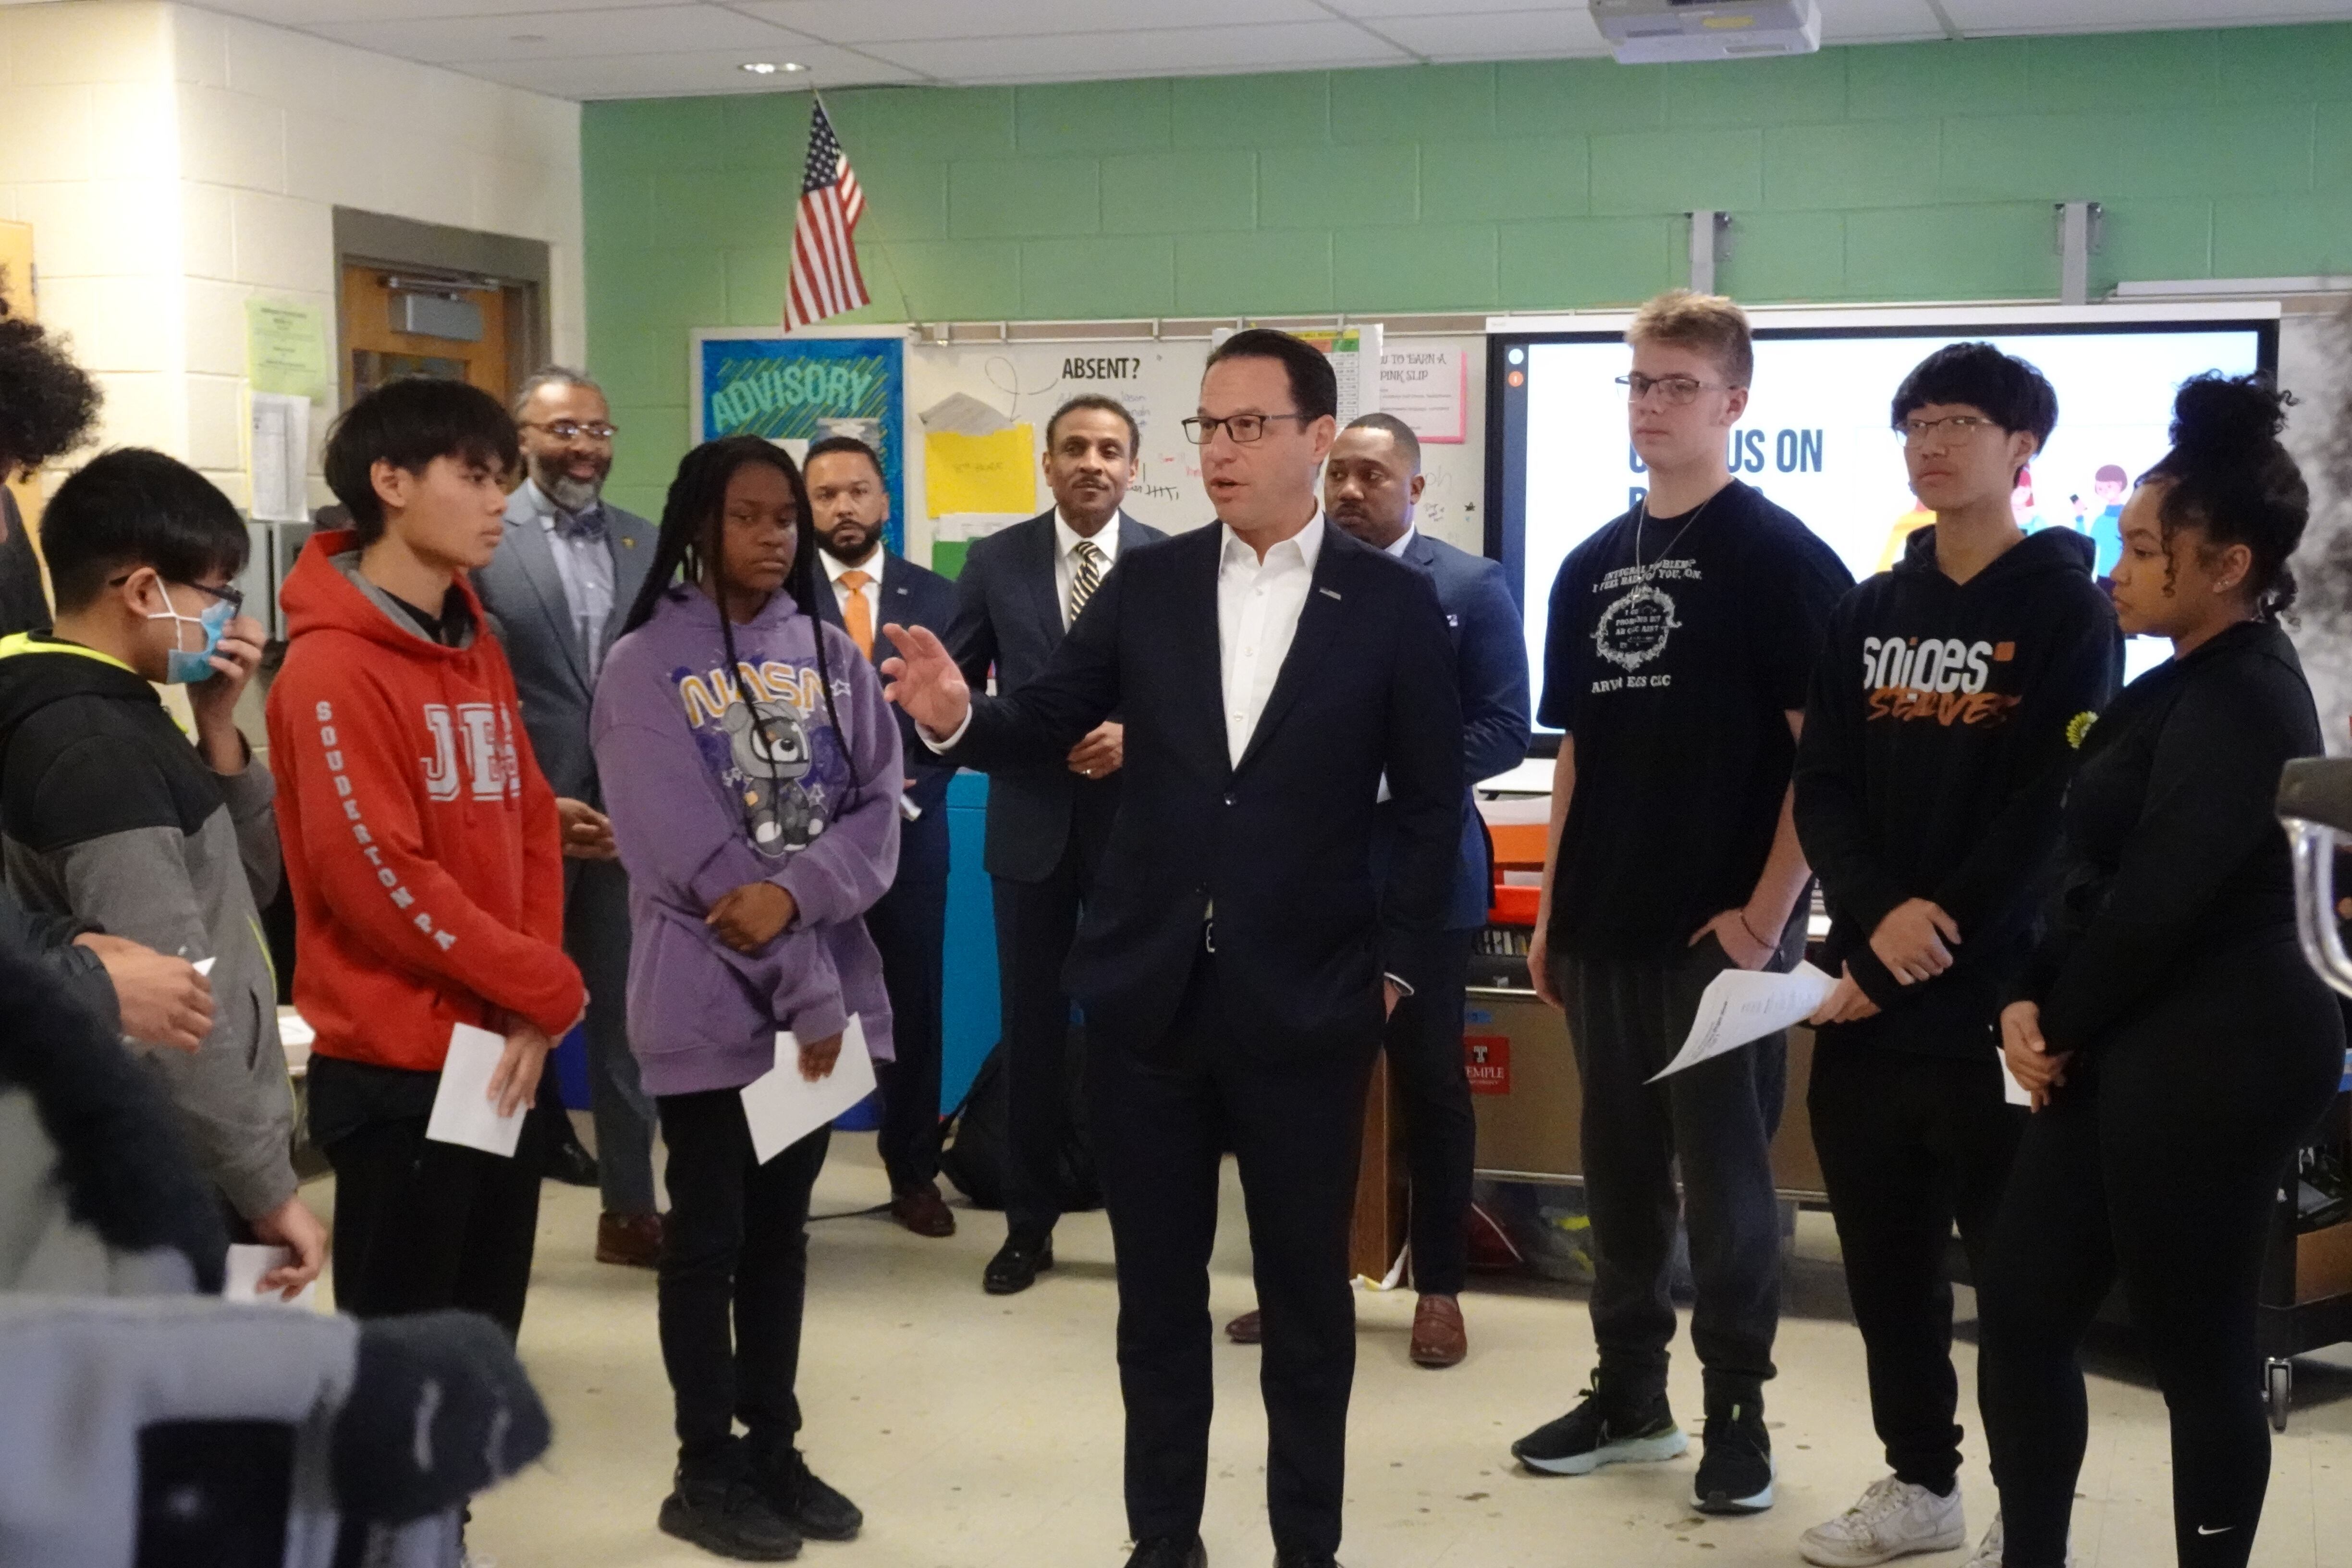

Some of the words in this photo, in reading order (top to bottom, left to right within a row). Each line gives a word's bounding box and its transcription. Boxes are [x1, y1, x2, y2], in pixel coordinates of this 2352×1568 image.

[1062, 358, 1140, 379] ABSENT?
[1391, 354, 1405, 365] TO
[1407, 353, 1435, 365] EARN
[1437, 353, 1446, 365] A
[1380, 370, 1404, 383] PINK
[1406, 370, 1429, 381] SLIP
[711, 364, 873, 433] ADVISORY
[1777, 429, 1823, 473] ON
[679, 661, 827, 728] NASA
[315, 700, 415, 909] SOUDERTON
[414, 913, 457, 951] PA
[1473, 1045, 1488, 1063] T
